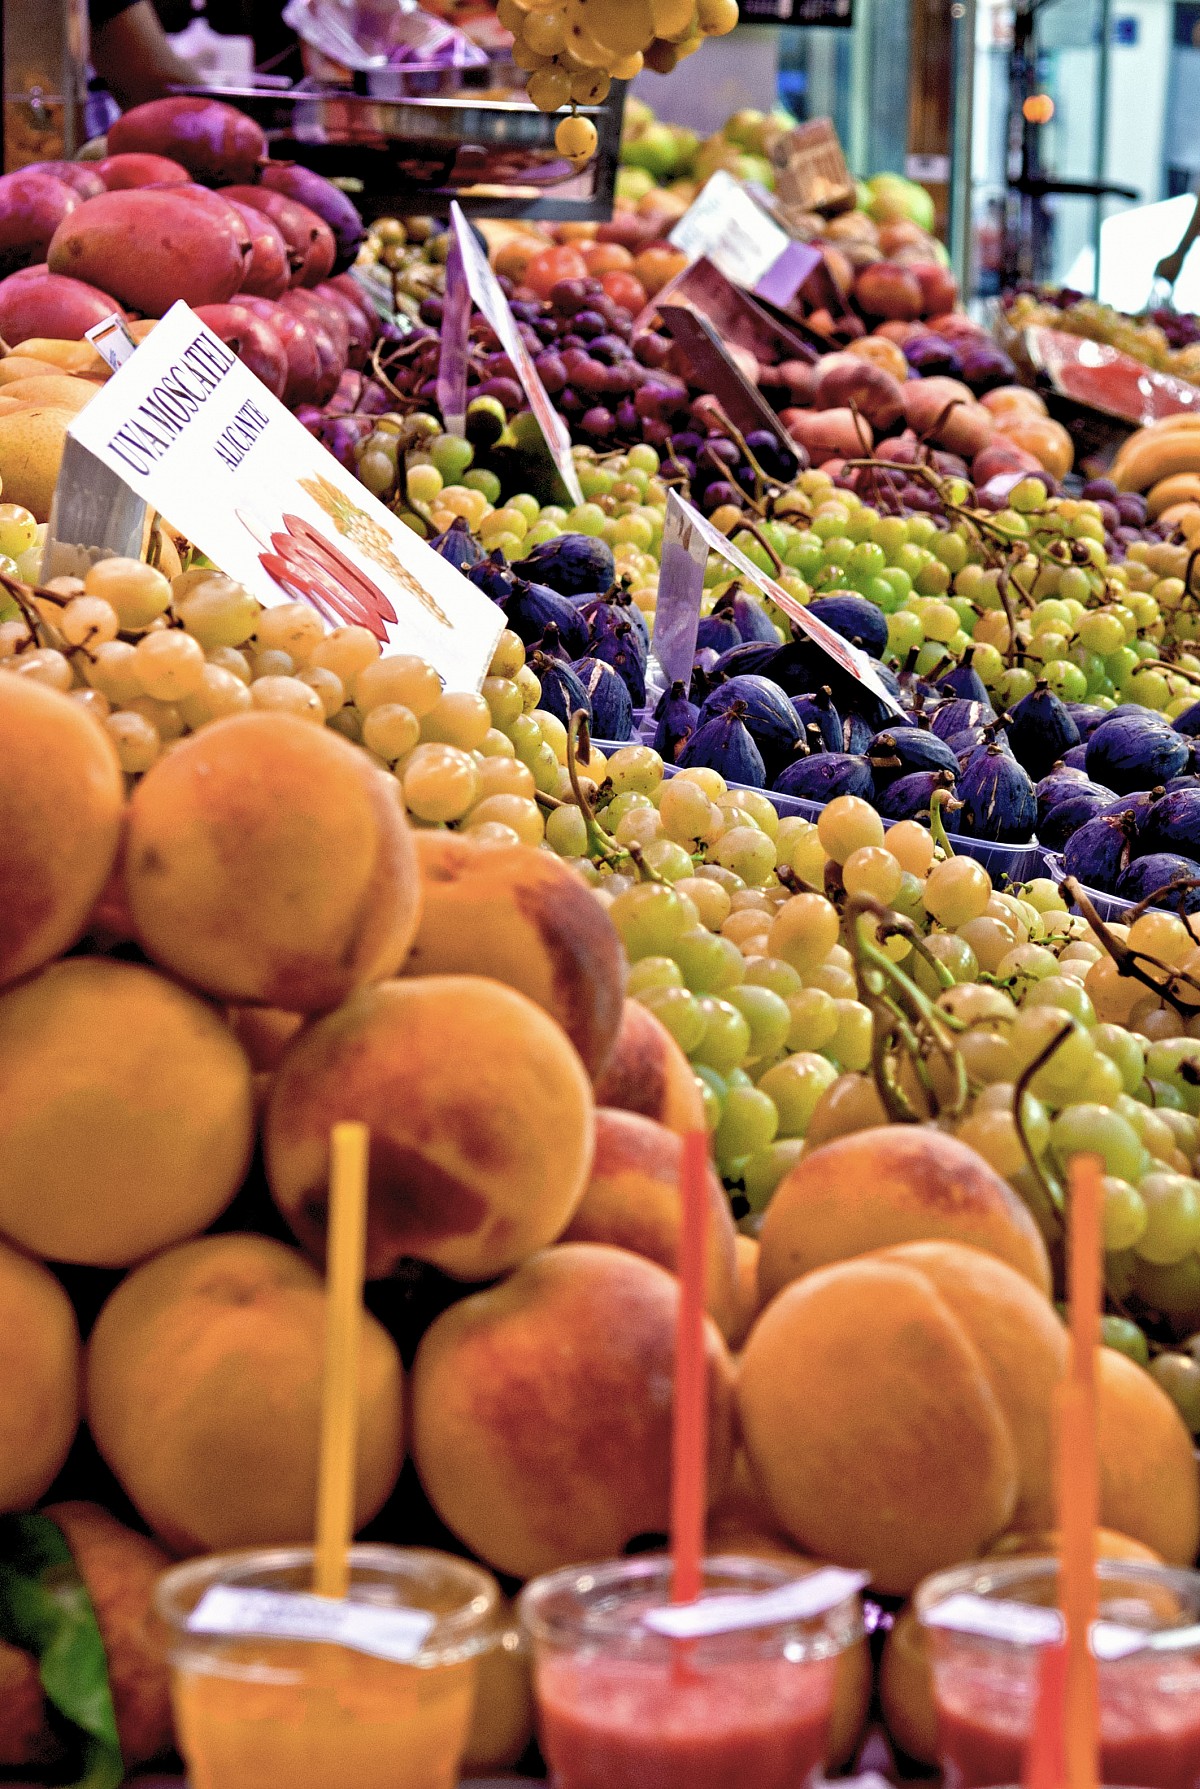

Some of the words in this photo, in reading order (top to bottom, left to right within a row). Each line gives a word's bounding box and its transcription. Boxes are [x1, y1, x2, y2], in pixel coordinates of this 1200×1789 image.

[137, 330, 237, 442] MOSCATEL
[106, 417, 170, 477] UVA
[212, 398, 270, 473] ALICANTE
